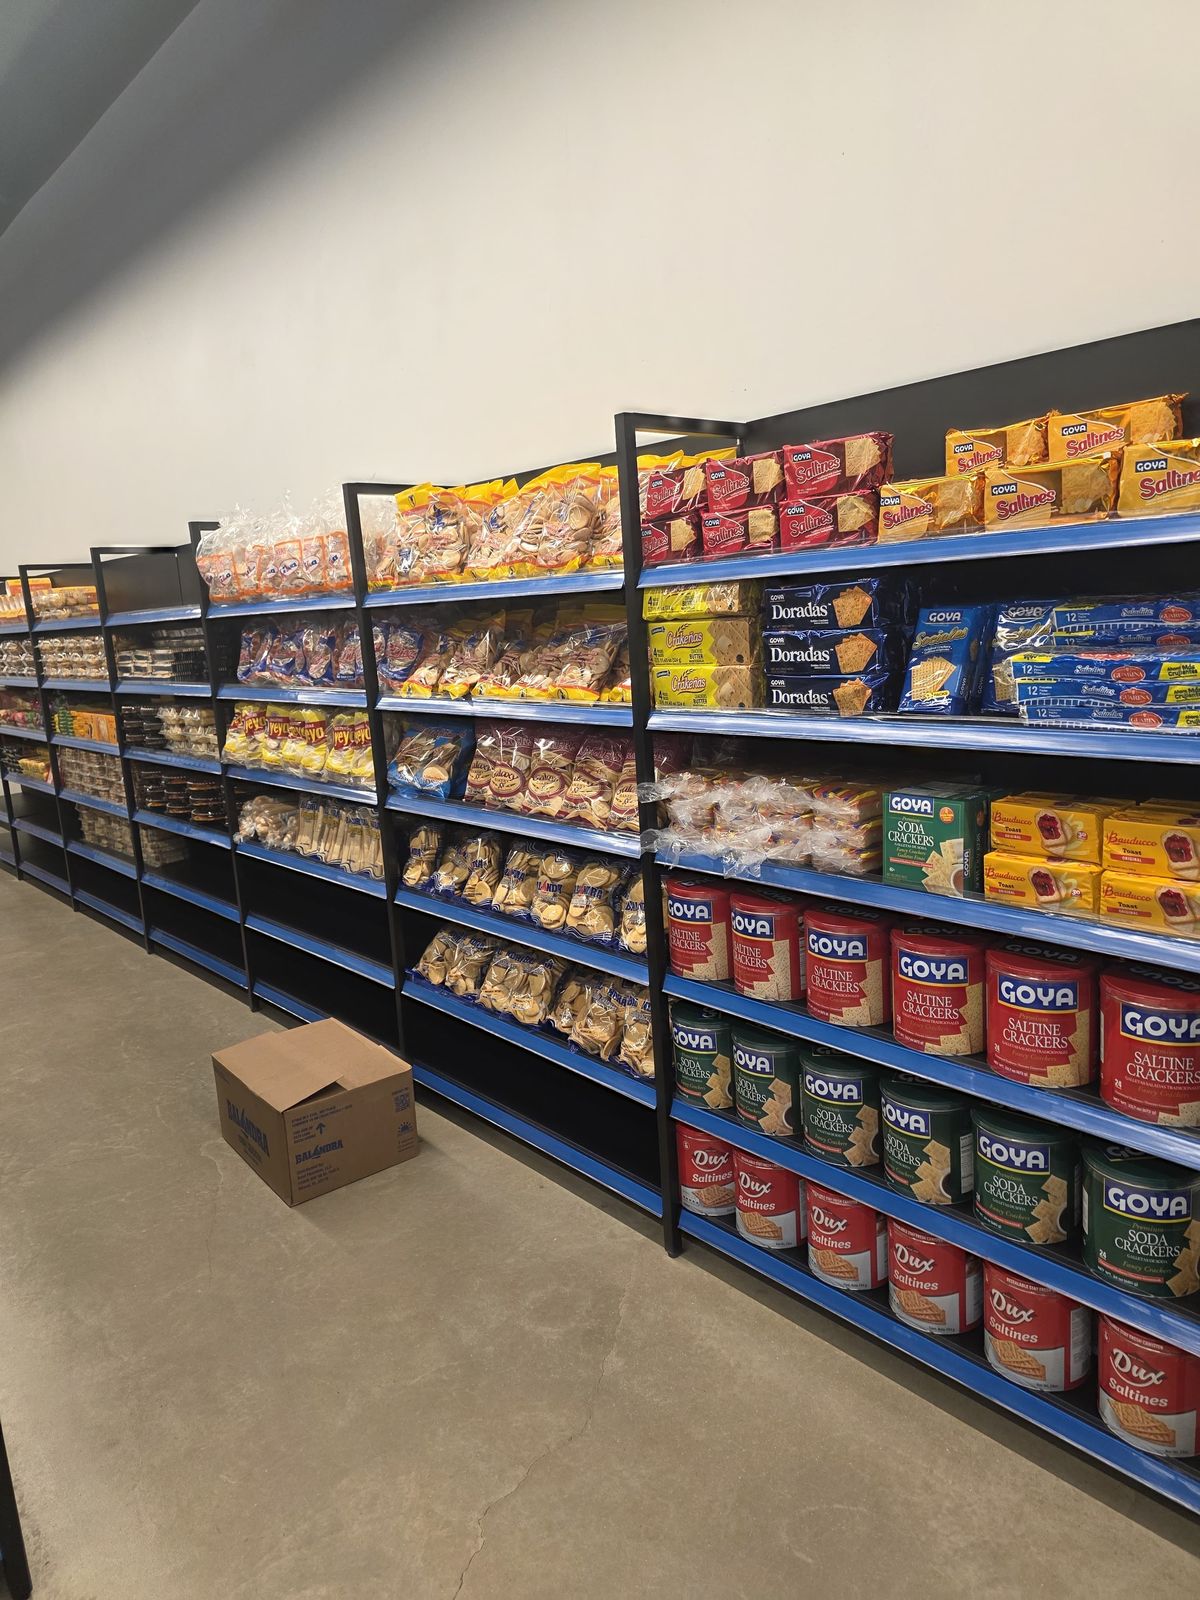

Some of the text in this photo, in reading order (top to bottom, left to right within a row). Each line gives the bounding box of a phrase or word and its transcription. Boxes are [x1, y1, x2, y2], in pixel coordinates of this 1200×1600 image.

[1062, 423, 1087, 435] GOYA
[954, 443, 973, 454] GOYA
[1065, 427, 1125, 458] Saltines
[793, 453, 811, 461] GOYA
[957, 447, 1002, 473] Saltines
[1136, 459, 1167, 471] GOYA
[795, 458, 840, 484] Saltines
[713, 477, 749, 500] Saltines
[992, 483, 1017, 495] GOYA
[1139, 468, 1200, 499] Saltine
[880, 496, 900, 506] GOYA
[996, 489, 1056, 520] Saltines
[787, 507, 804, 515] GOYA
[882, 502, 933, 529] Saltines
[705, 519, 720, 527] GOYA
[789, 514, 833, 537] Saltines
[707, 526, 744, 547] Saltines
[772, 602, 828, 620] Doradas
[929, 612, 961, 623] GOYA
[1065, 613, 1077, 622] 12
[771, 646, 830, 662] Doradas
[1022, 665, 1033, 674] 12
[772, 689, 829, 704] Doradas
[1027, 686, 1038, 695] 12
[1036, 708, 1047, 717] 12
[891, 797, 932, 813] GOYA
[897, 820, 925, 835] SODA
[993, 811, 1032, 825] Bauducco
[888, 831, 934, 847] CRACKERS
[1107, 831, 1157, 847] Bauducco
[1122, 847, 1142, 855] Toast
[986, 867, 1025, 882] Bauducco
[1103, 883, 1152, 902] Bauducco
[668, 899, 708, 919] GOYA
[671, 927, 700, 941] SALTINE
[809, 934, 864, 956] GOYA
[814, 965, 853, 982] SALTINE
[900, 956, 964, 980] GOYA
[811, 974, 860, 993] CRACKERS
[906, 990, 952, 1008] SALTINE
[1001, 981, 1074, 1006] GOYA
[902, 1000, 959, 1019] CRACKERS
[1008, 1017, 1061, 1036] SALTINE
[673, 1026, 713, 1049] GOYA
[1002, 1028, 1068, 1049] CRACKERS
[680, 1056, 702, 1071] SODA
[1134, 1051, 1195, 1071] SALTINE
[1126, 1063, 1200, 1084] CRACKERS
[738, 1077, 758, 1093] SODA
[805, 1074, 858, 1099] GOYA
[810, 1114, 854, 1133] CRACKERS
[816, 1108, 844, 1124] SODA
[887, 1133, 911, 1155] SODA
[979, 1136, 1045, 1169] GOYA
[693, 1150, 729, 1166] Dux
[692, 1171, 733, 1183] Saltines
[739, 1171, 772, 1194] Dux
[992, 1175, 1026, 1195] SODA
[738, 1195, 776, 1211] Saltines
[984, 1181, 1038, 1206] CRACKERS
[1108, 1187, 1187, 1216] GOYA
[812, 1205, 848, 1231] Dux
[811, 1230, 852, 1249] Saltines
[1114, 1237, 1180, 1257] CRACKERS
[1128, 1229, 1168, 1246] SODA
[895, 1243, 935, 1272] Dux
[894, 1269, 939, 1291] Saltines
[991, 1288, 1035, 1322] Dux
[989, 1316, 1039, 1343] Saltines
[1112, 1348, 1166, 1384] Dux
[1109, 1377, 1168, 1407] Saltines
